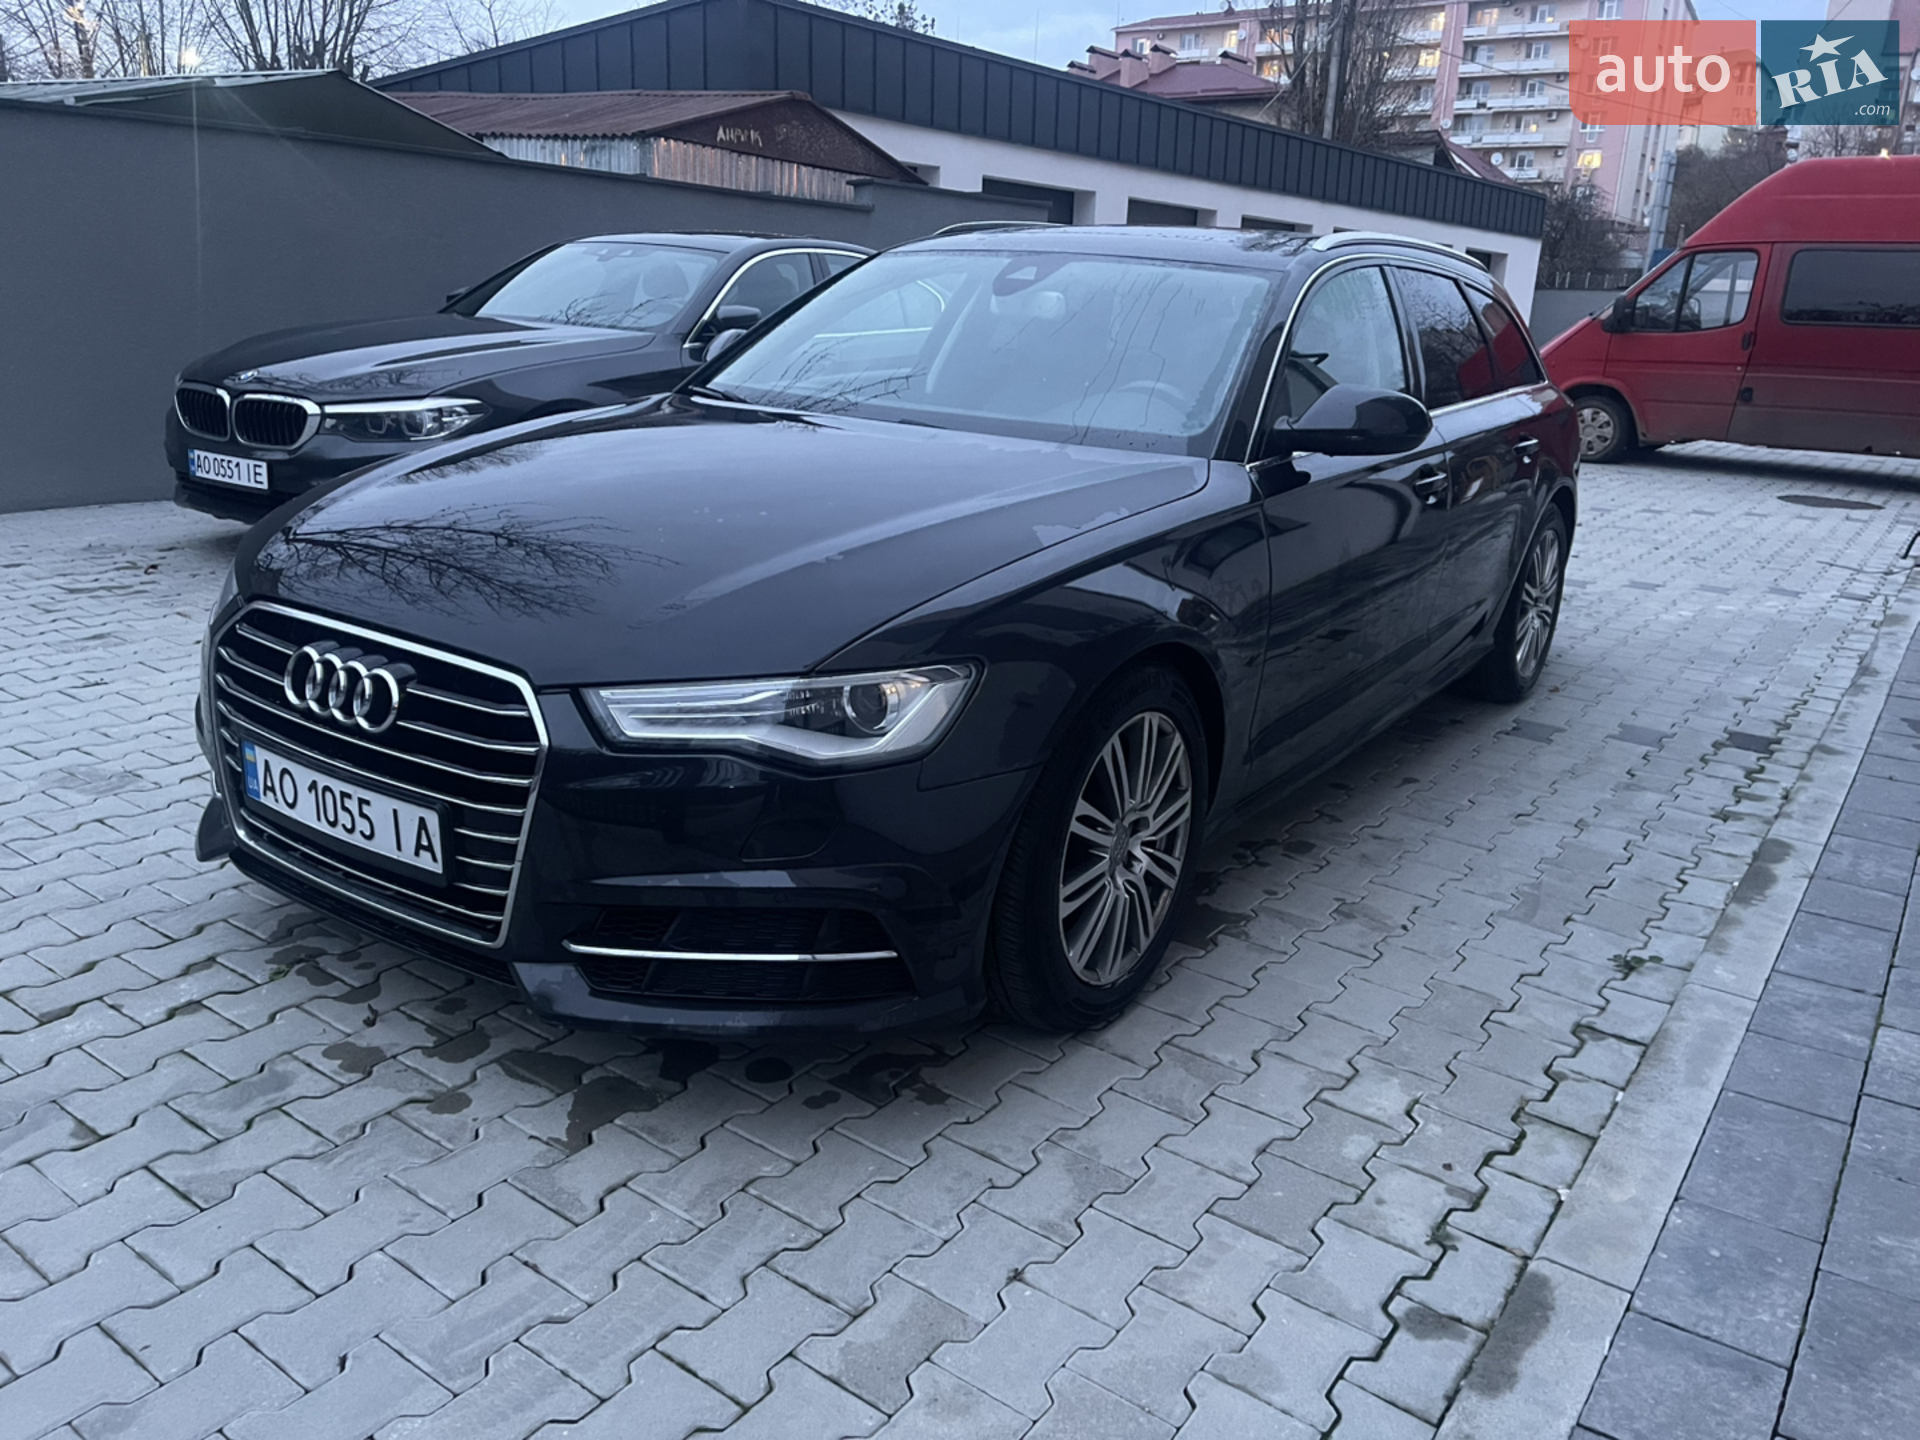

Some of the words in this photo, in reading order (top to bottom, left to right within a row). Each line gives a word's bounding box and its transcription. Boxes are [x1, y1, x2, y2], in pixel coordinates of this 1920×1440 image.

[197, 454, 211, 474] AO
[213, 457, 241, 481] 0551
[247, 463, 264, 485] IE
[263, 759, 298, 809] AO
[307, 779, 375, 840] 1055
[392, 808, 438, 863] IA
